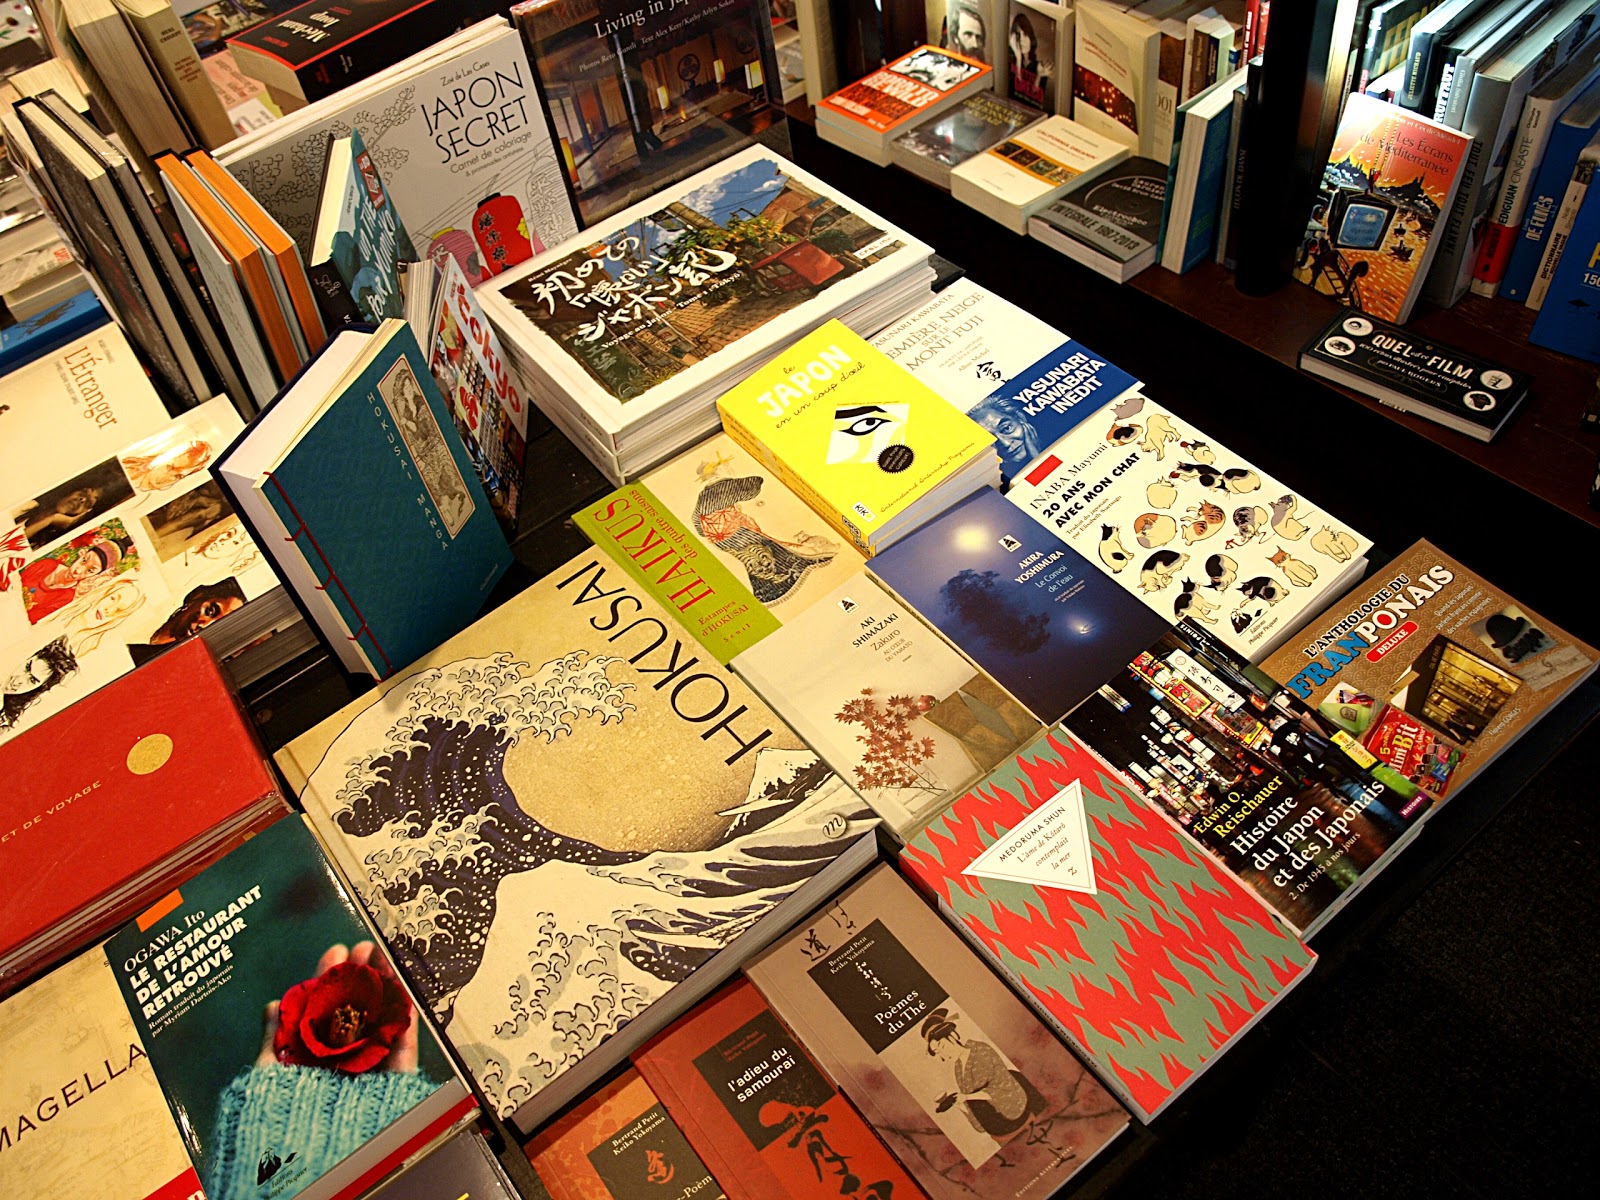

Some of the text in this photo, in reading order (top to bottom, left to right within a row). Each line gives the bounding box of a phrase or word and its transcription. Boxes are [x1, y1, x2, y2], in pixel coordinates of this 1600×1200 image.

[309, 11, 339, 28] loup
[594, 1, 664, 38] Living in
[455, 60, 490, 80] de Las Cases
[579, 28, 668, 72] Photos Text Alex
[421, 61, 524, 137] JAPON
[1434, 63, 1454, 123] RUFFAUT
[435, 95, 528, 164] SECRET
[450, 131, 532, 174] Carnet de coloriage
[1396, 132, 1454, 163] Les Écrans
[1360, 134, 1449, 175] de Méditerranée
[1499, 137, 1534, 225] ÉDIGUIAN CINÉASTE
[1541, 232, 1562, 279] DICTIONNAIRE
[601, 293, 703, 349] Voyage au Japon Tome
[885, 321, 942, 360] EMIÈRE
[942, 291, 985, 323] NEIGE
[911, 294, 955, 323] KAWABATA
[906, 340, 953, 371] MONT
[954, 314, 985, 338] FUJI
[921, 326, 952, 347] SUR LE
[1372, 334, 1473, 379] QUEL FILM
[64, 345, 118, 430] L'Étranger
[757, 345, 852, 418] JAPON
[1012, 351, 1090, 403] YASUNARI
[1022, 359, 1107, 417] KAWABATA
[776, 417, 791, 429] en
[794, 403, 811, 416] un
[814, 382, 838, 400] coup
[367, 392, 448, 551] HOKUSAI MANGA
[1029, 442, 1108, 511] INABA Mayumi
[1055, 452, 1141, 529] AVEC MON CHAT
[1042, 479, 1087, 519] 20 ANS
[630, 488, 698, 559] des quatre saisons
[592, 496, 716, 614] HAIKUS
[1015, 550, 1064, 584] YOSHIMURA
[1018, 551, 1044, 569] AKIRA
[1035, 565, 1068, 588] Le Convoi
[1048, 584, 1058, 593] de
[1057, 574, 1074, 587] l'eau
[698, 600, 737, 626] Estampes
[701, 602, 750, 638] d'HOKUSAI
[722, 622, 752, 643] Seuil
[852, 613, 899, 648] SHIMAZAKI
[860, 616, 875, 629] AKI
[1180, 623, 1200, 641] POINTS
[1285, 565, 1456, 700] FRANPONAIS
[1303, 573, 1411, 659] L'ANTHOLOGIE DU
[870, 629, 901, 651] Zakuro
[1376, 628, 1409, 657] DELUXE
[555, 560, 773, 768] HOKUSAI
[1380, 747, 1390, 755] 5
[1, 781, 102, 843] ET DE VOYAGE
[1193, 790, 1243, 835] Edwin O.
[1213, 775, 1284, 839] Reischauer
[1229, 795, 1298, 856] Histoire
[999, 807, 1066, 862] MEDORUMA SHUN
[1017, 846, 1037, 863] L'âme
[1035, 836, 1069, 866] contemplait
[1252, 804, 1325, 871] du Japon
[1273, 779, 1385, 888] et des Japonais
[1051, 852, 1071, 870] la mer
[1288, 890, 1300, 901] 2.
[1297, 879, 1310, 891] De
[1307, 864, 1327, 883] 1945
[1329, 847, 1345, 863] nos
[1343, 832, 1361, 854] jours
[124, 910, 205, 972] OGAWA Ito
[129, 885, 262, 990] LE RESTAURANT
[136, 917, 248, 1005] DE L'AMOUR
[828, 936, 868, 967] Bertrand Petit
[830, 939, 875, 975] Keiko Yokoyama
[142, 943, 234, 1020] RETROUVÉ
[148, 964, 234, 1030] Roman traduit du japonais
[151, 974, 232, 1038] par Myriam Dartois-Ako
[874, 990, 919, 1024] Poèmes
[888, 1000, 927, 1034] du Thé
[727, 1047, 788, 1092] l'adieu du
[737, 1055, 796, 1103] samouraï
[0, 1043, 147, 1151] MAGELLA
[612, 1112, 659, 1147] Bertrand Petit
[612, 1116, 666, 1156] Keiko Yokoyama
